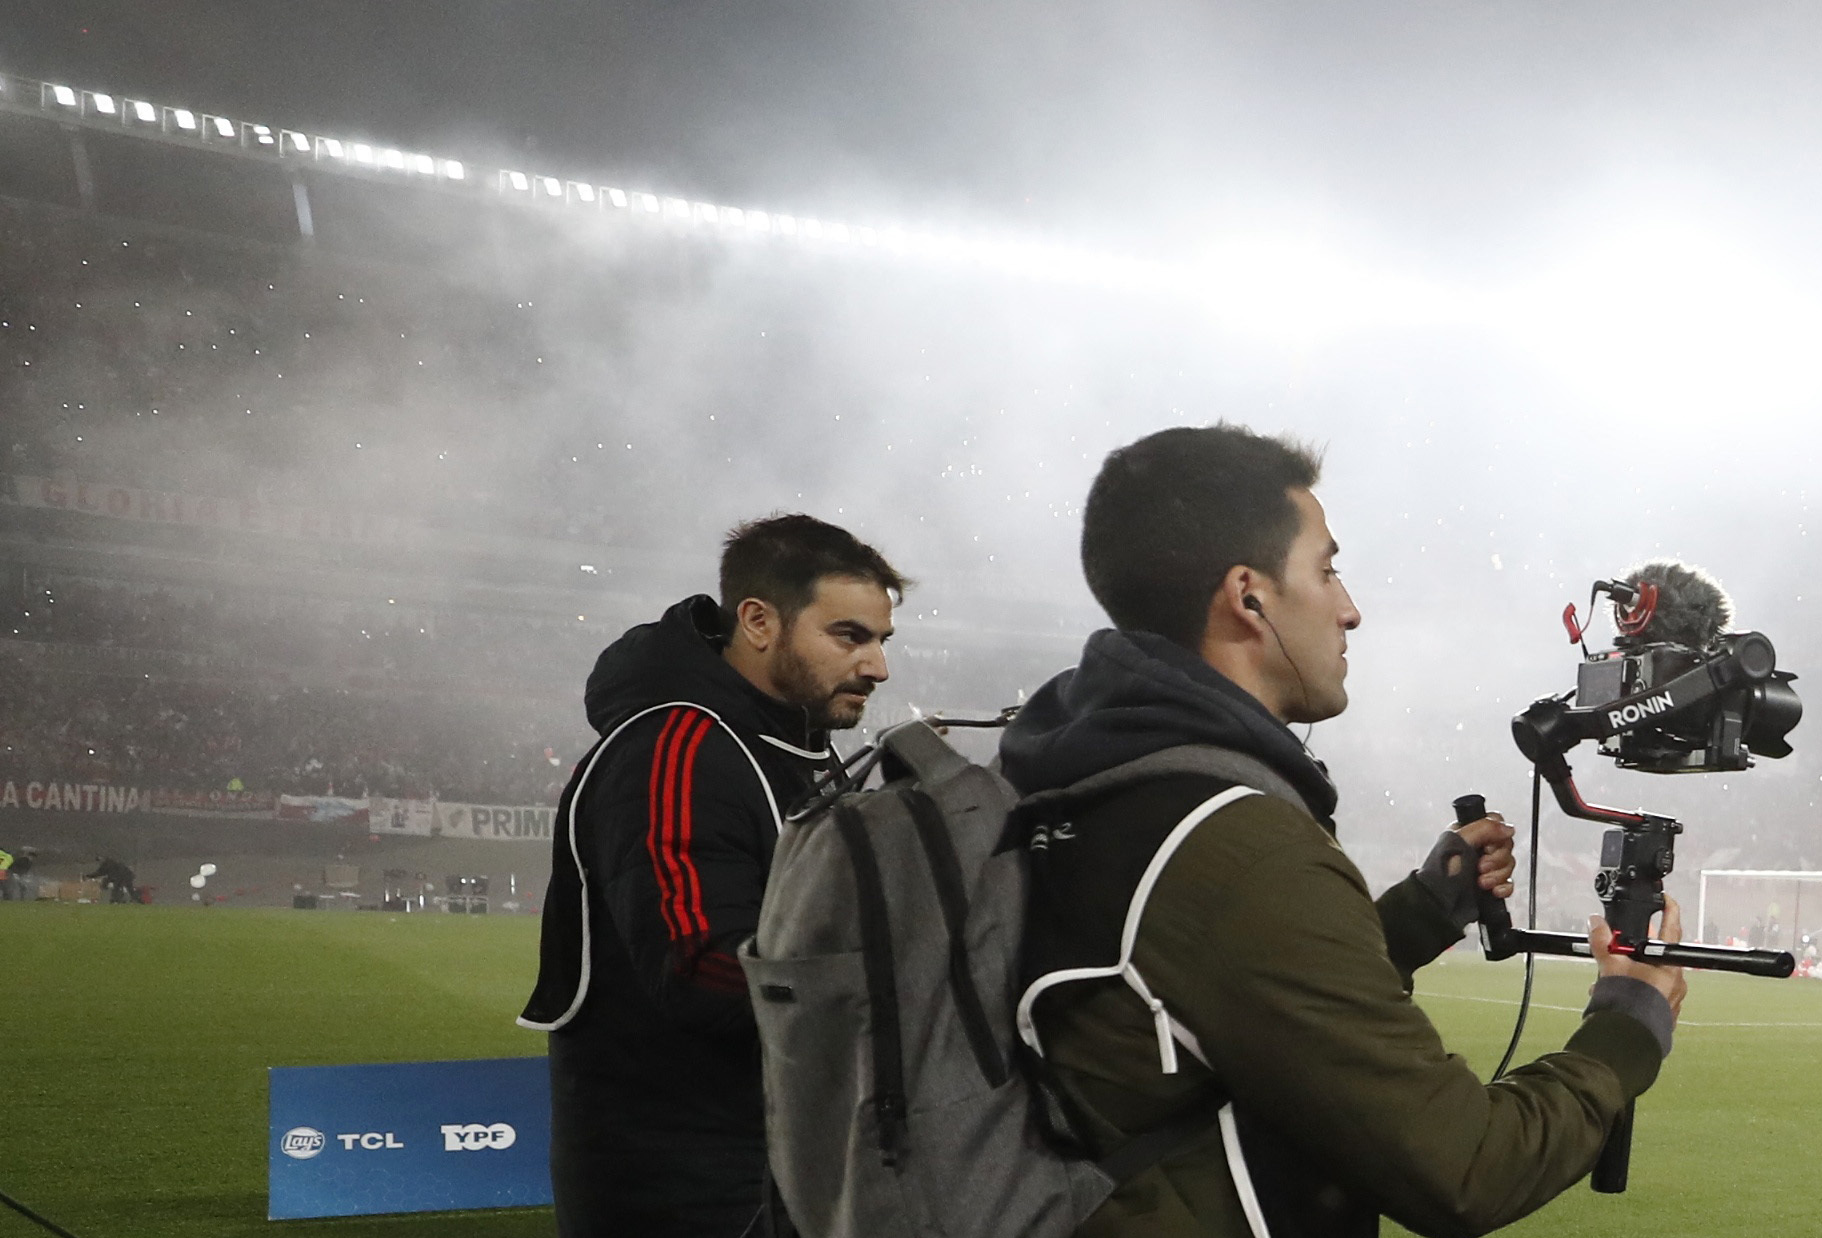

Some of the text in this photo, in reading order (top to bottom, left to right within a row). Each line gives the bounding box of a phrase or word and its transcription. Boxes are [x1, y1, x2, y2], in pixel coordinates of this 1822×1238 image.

[1608, 690, 1674, 728] RONIN
[26, 781, 140, 813] CANTINA
[336, 1132, 404, 1150] TCL
[453, 1130, 506, 1143] YPF
